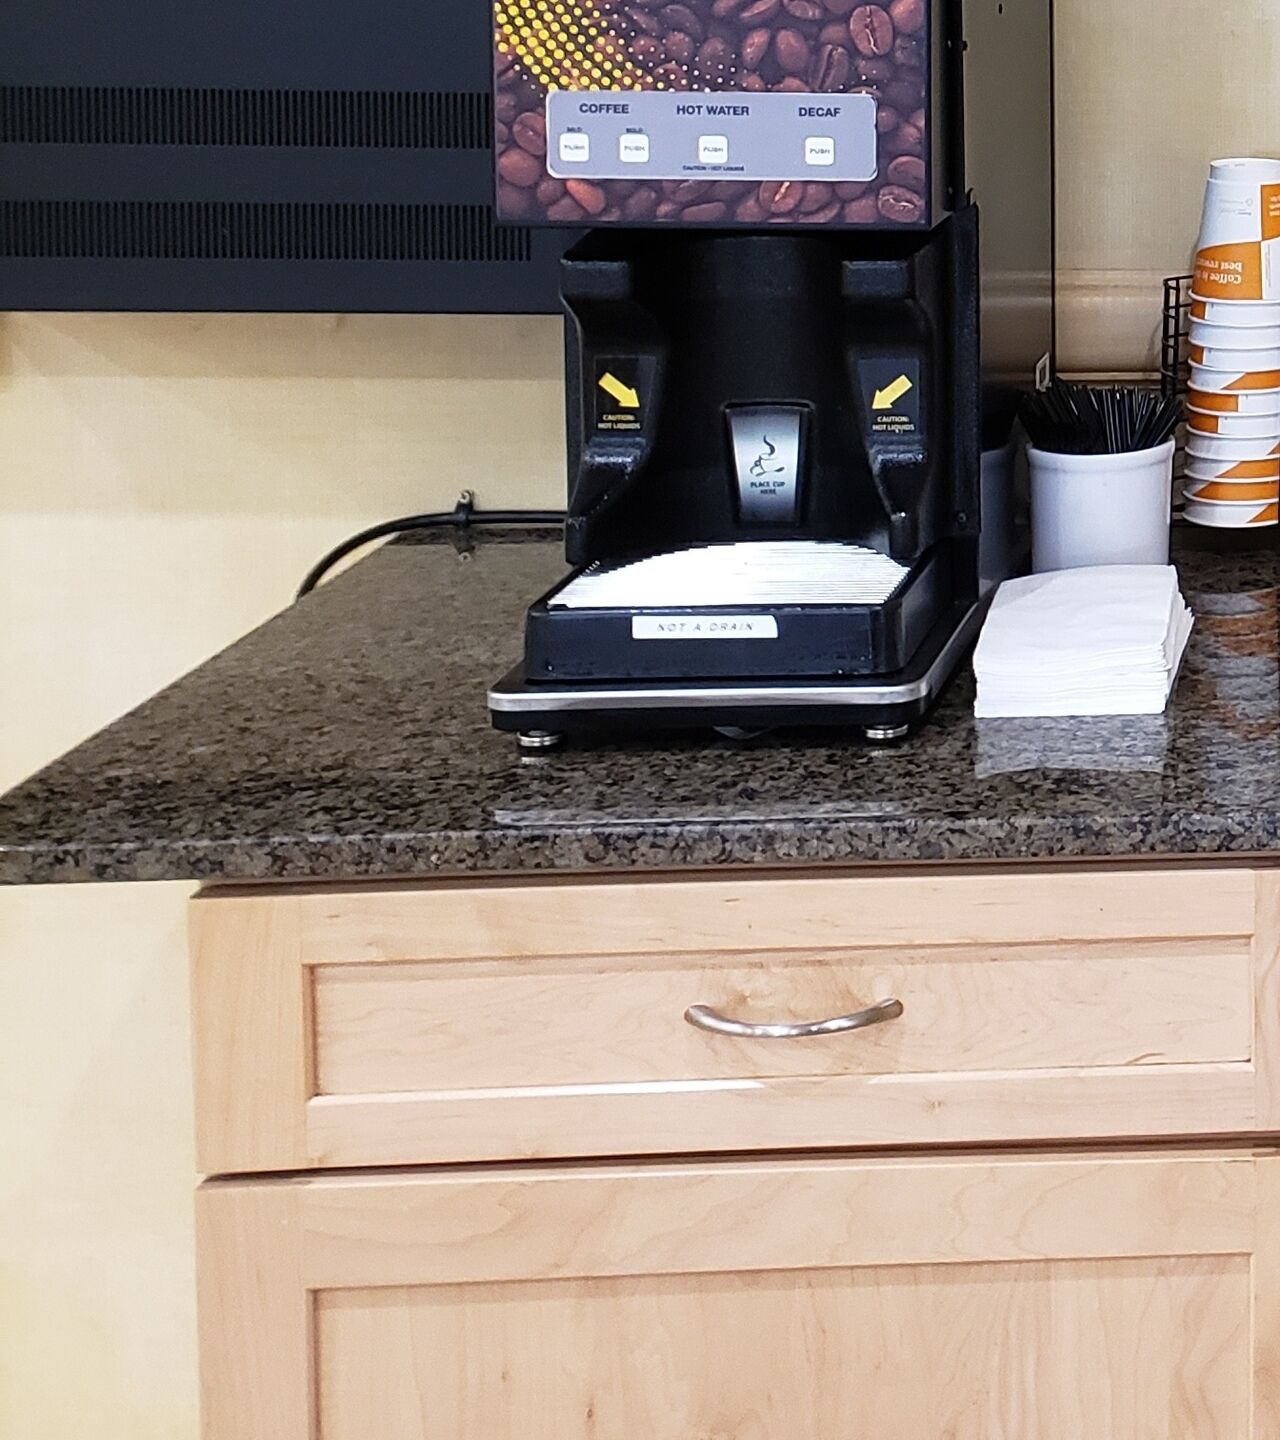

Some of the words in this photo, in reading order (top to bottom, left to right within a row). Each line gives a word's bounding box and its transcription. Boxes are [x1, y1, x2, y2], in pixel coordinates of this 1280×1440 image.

[579, 103, 630, 114] COFFEE
[676, 105, 703, 115] HOT
[704, 105, 750, 116] WATER
[798, 107, 842, 117] DECAF
[1221, 261, 1243, 273] best
[1210, 272, 1242, 285] Coffee
[657, 622, 688, 632] NOT
[694, 622, 702, 632] A
[709, 622, 754, 632] DRAIN
